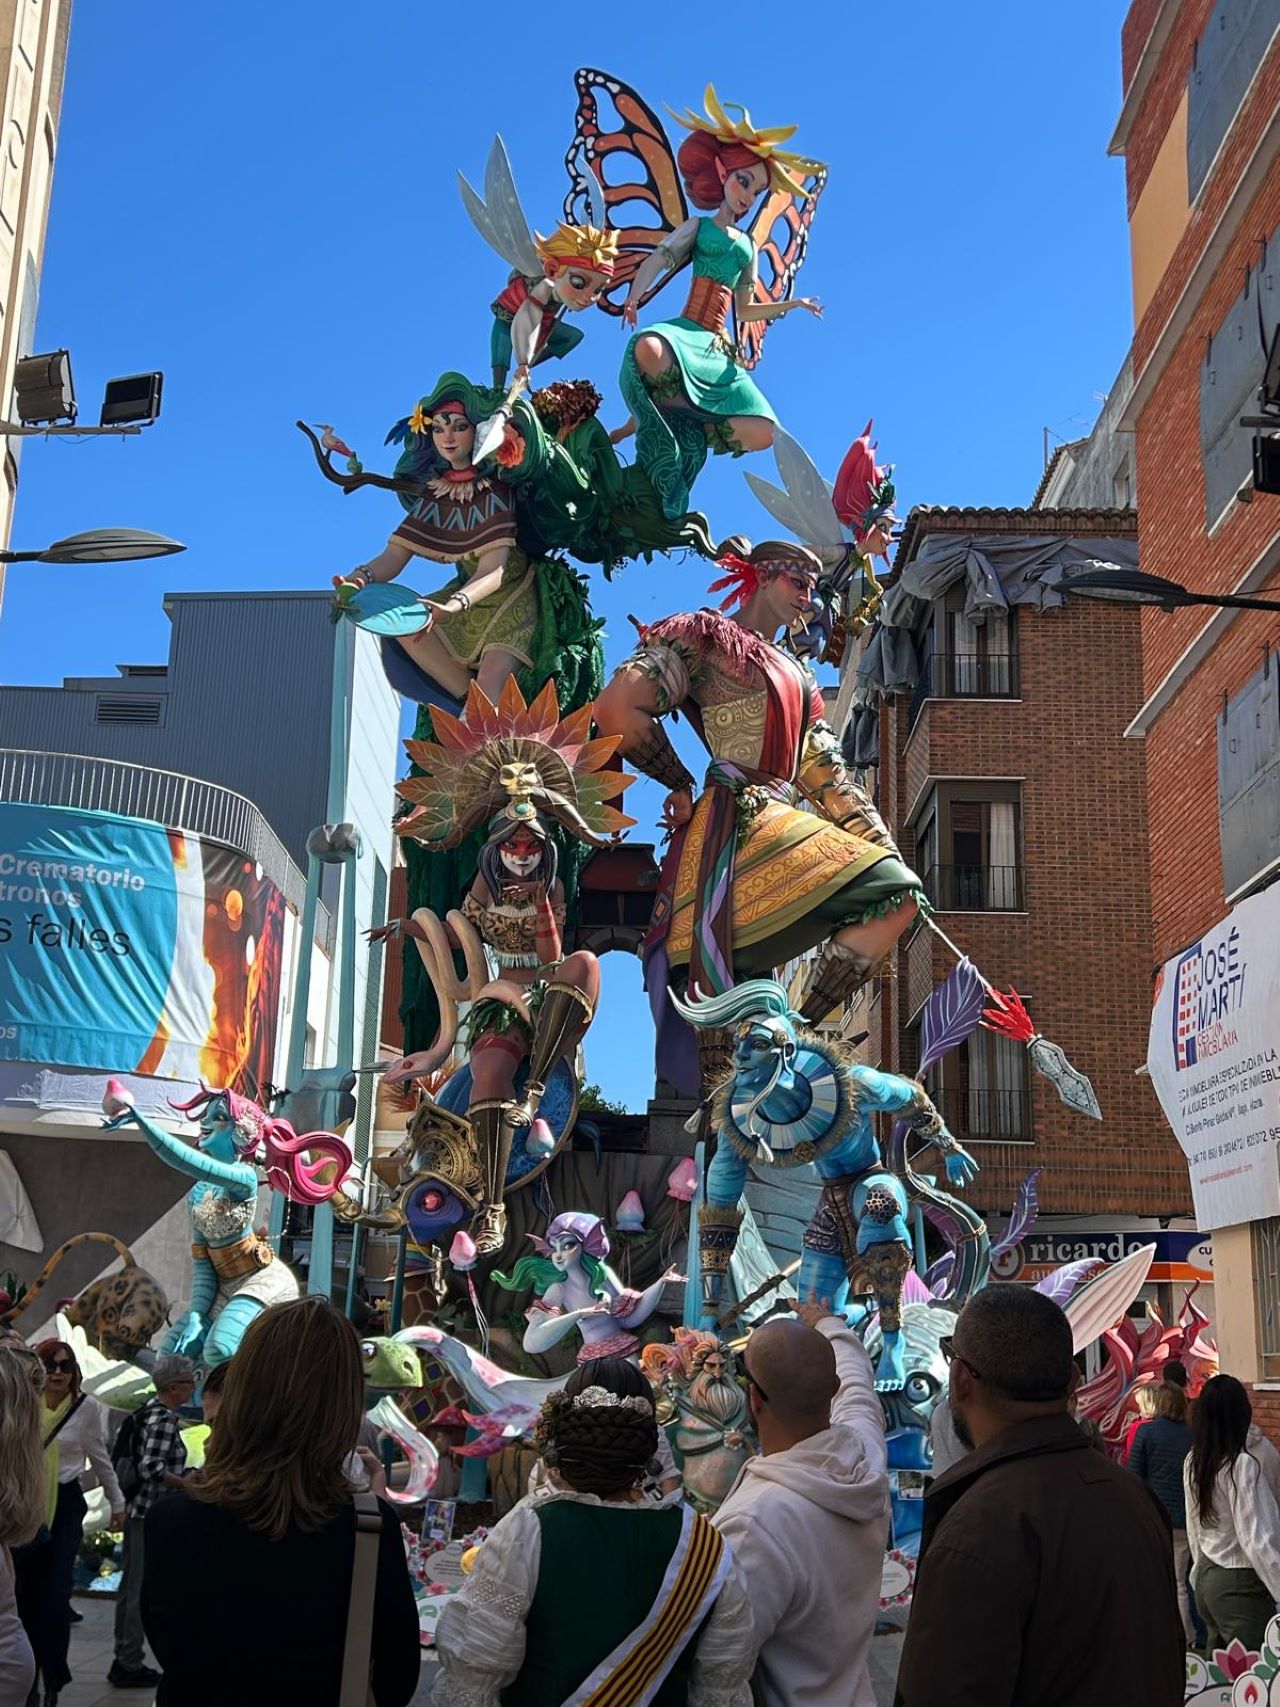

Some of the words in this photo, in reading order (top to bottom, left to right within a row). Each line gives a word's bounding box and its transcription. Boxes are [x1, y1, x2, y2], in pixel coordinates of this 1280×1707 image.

[0, 853, 145, 891] Crematorio
[27, 913, 130, 956] falles
[1197, 926, 1240, 991] JOSÉ
[1198, 963, 1247, 1032] MARTÍ
[1264, 1048, 1278, 1062] LA
[1030, 1234, 1144, 1261] ricardo
